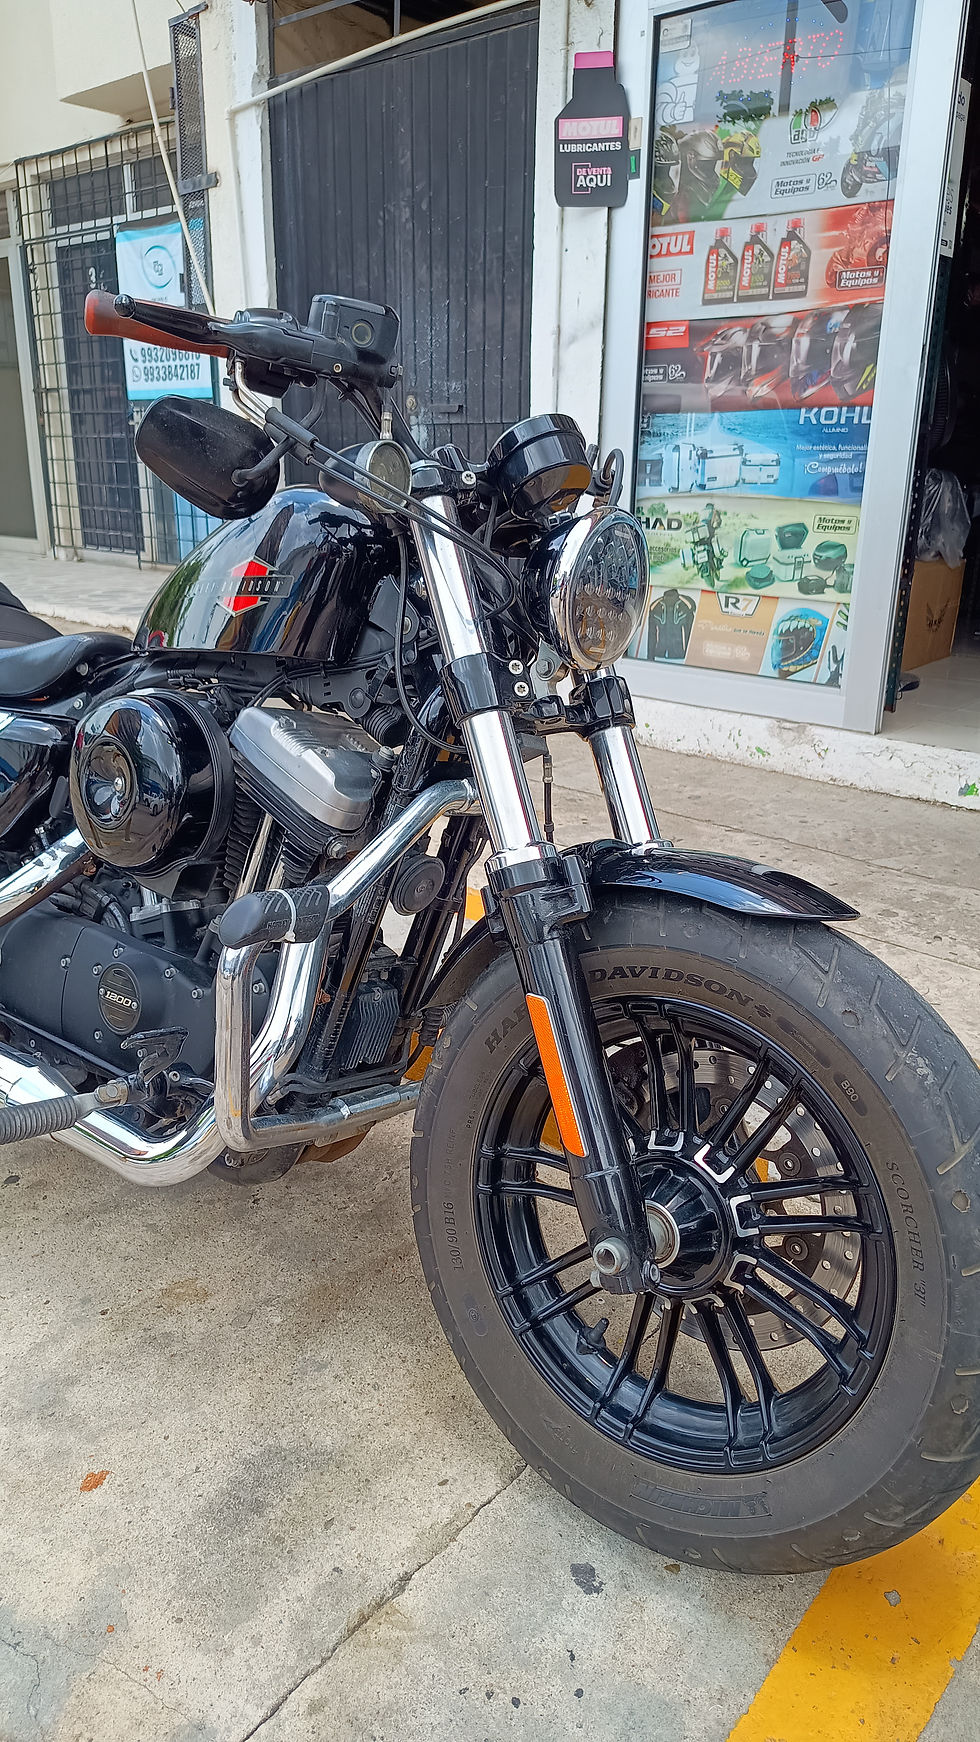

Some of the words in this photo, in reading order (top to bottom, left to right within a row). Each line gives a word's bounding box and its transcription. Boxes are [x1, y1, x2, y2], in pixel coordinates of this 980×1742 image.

[562, 119, 620, 137] MOTUL
[559, 141, 622, 153] LUBRICANTES
[774, 178, 805, 187] Motos
[774, 185, 810, 196] Equipos
[650, 235, 691, 256] OTUL
[707, 253, 717, 291] MOTUL
[741, 249, 753, 287] MOTUL
[777, 245, 789, 284] MOTUL
[840, 270, 872, 280] Motos
[840, 278, 879, 288] Equipos
[647, 288, 681, 299] RICANTE
[647, 326, 686, 338] S2
[143, 362, 201, 383] 9933842187
[639, 517, 683, 532] HAD
[816, 523, 851, 532] Equipos
[724, 595, 753, 612] R7
[105, 991, 132, 1007] 1200
[485, 1001, 528, 1055] HAR
[588, 965, 754, 1007] DAVIDSON
[886, 1161, 925, 1272] SCORCHER
